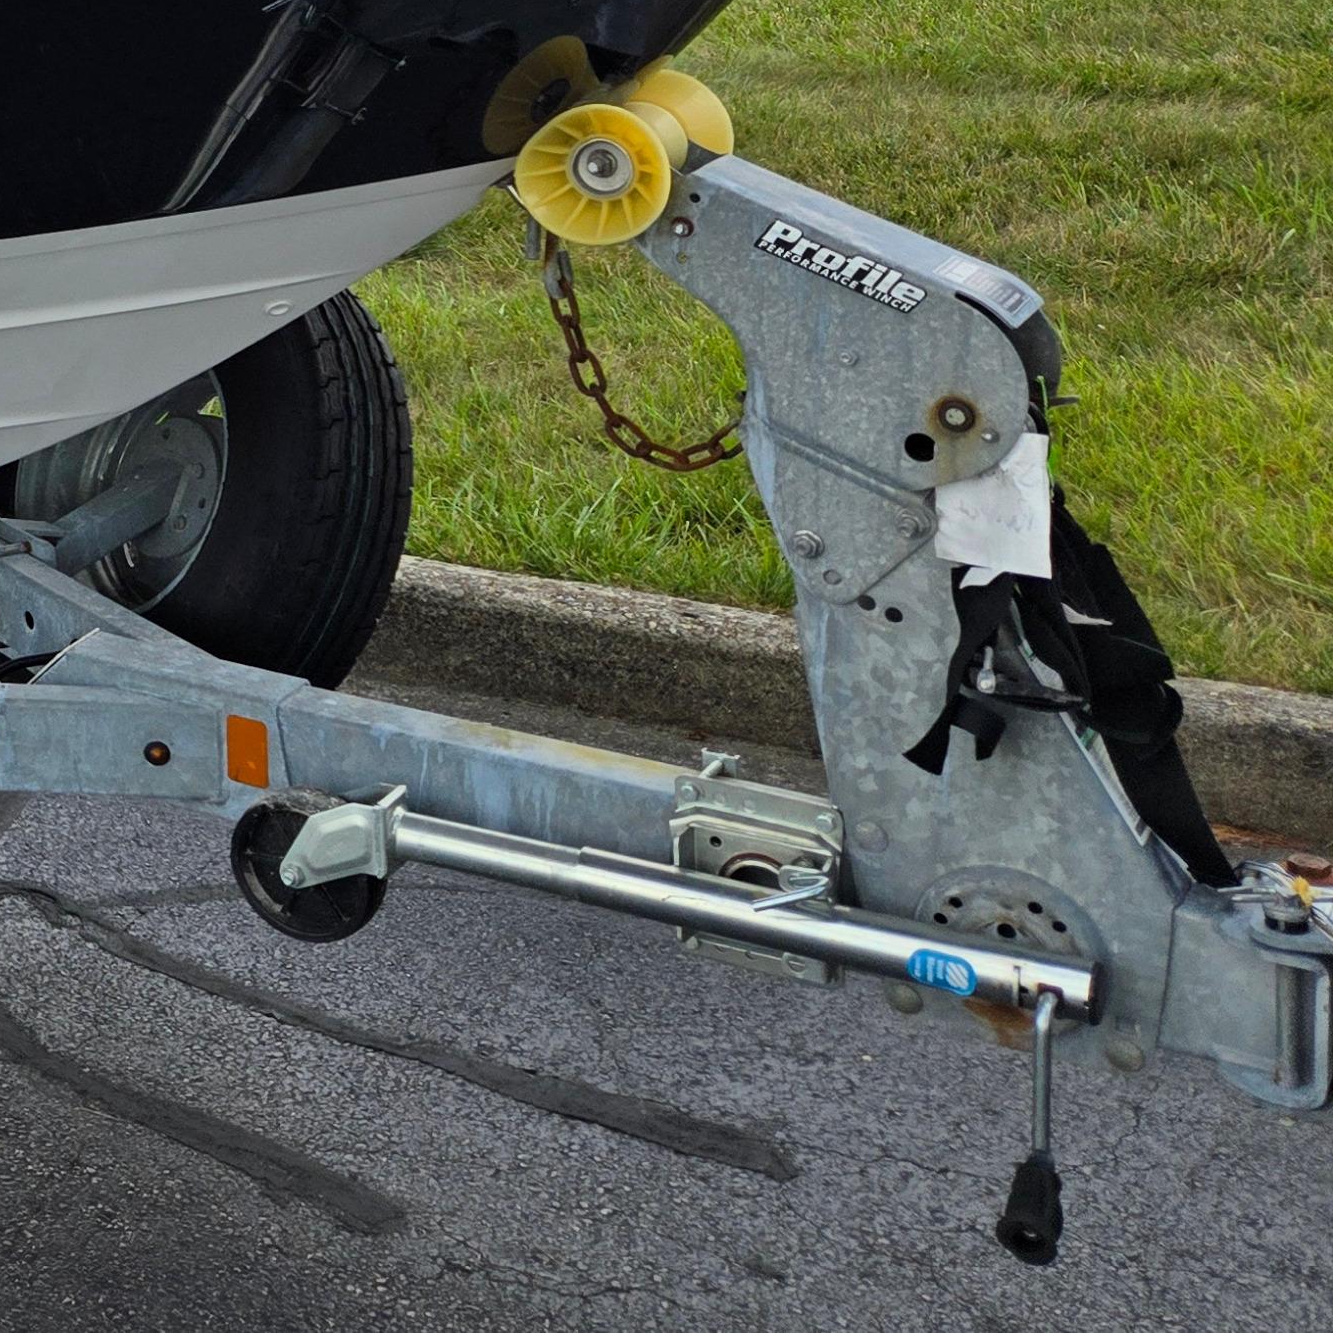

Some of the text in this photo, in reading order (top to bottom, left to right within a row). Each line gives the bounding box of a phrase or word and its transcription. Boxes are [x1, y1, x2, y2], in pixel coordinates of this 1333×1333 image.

[758, 241, 859, 289] PERFORMANCE
[862, 285, 913, 312] WINCH
[762, 220, 926, 307] Profile
